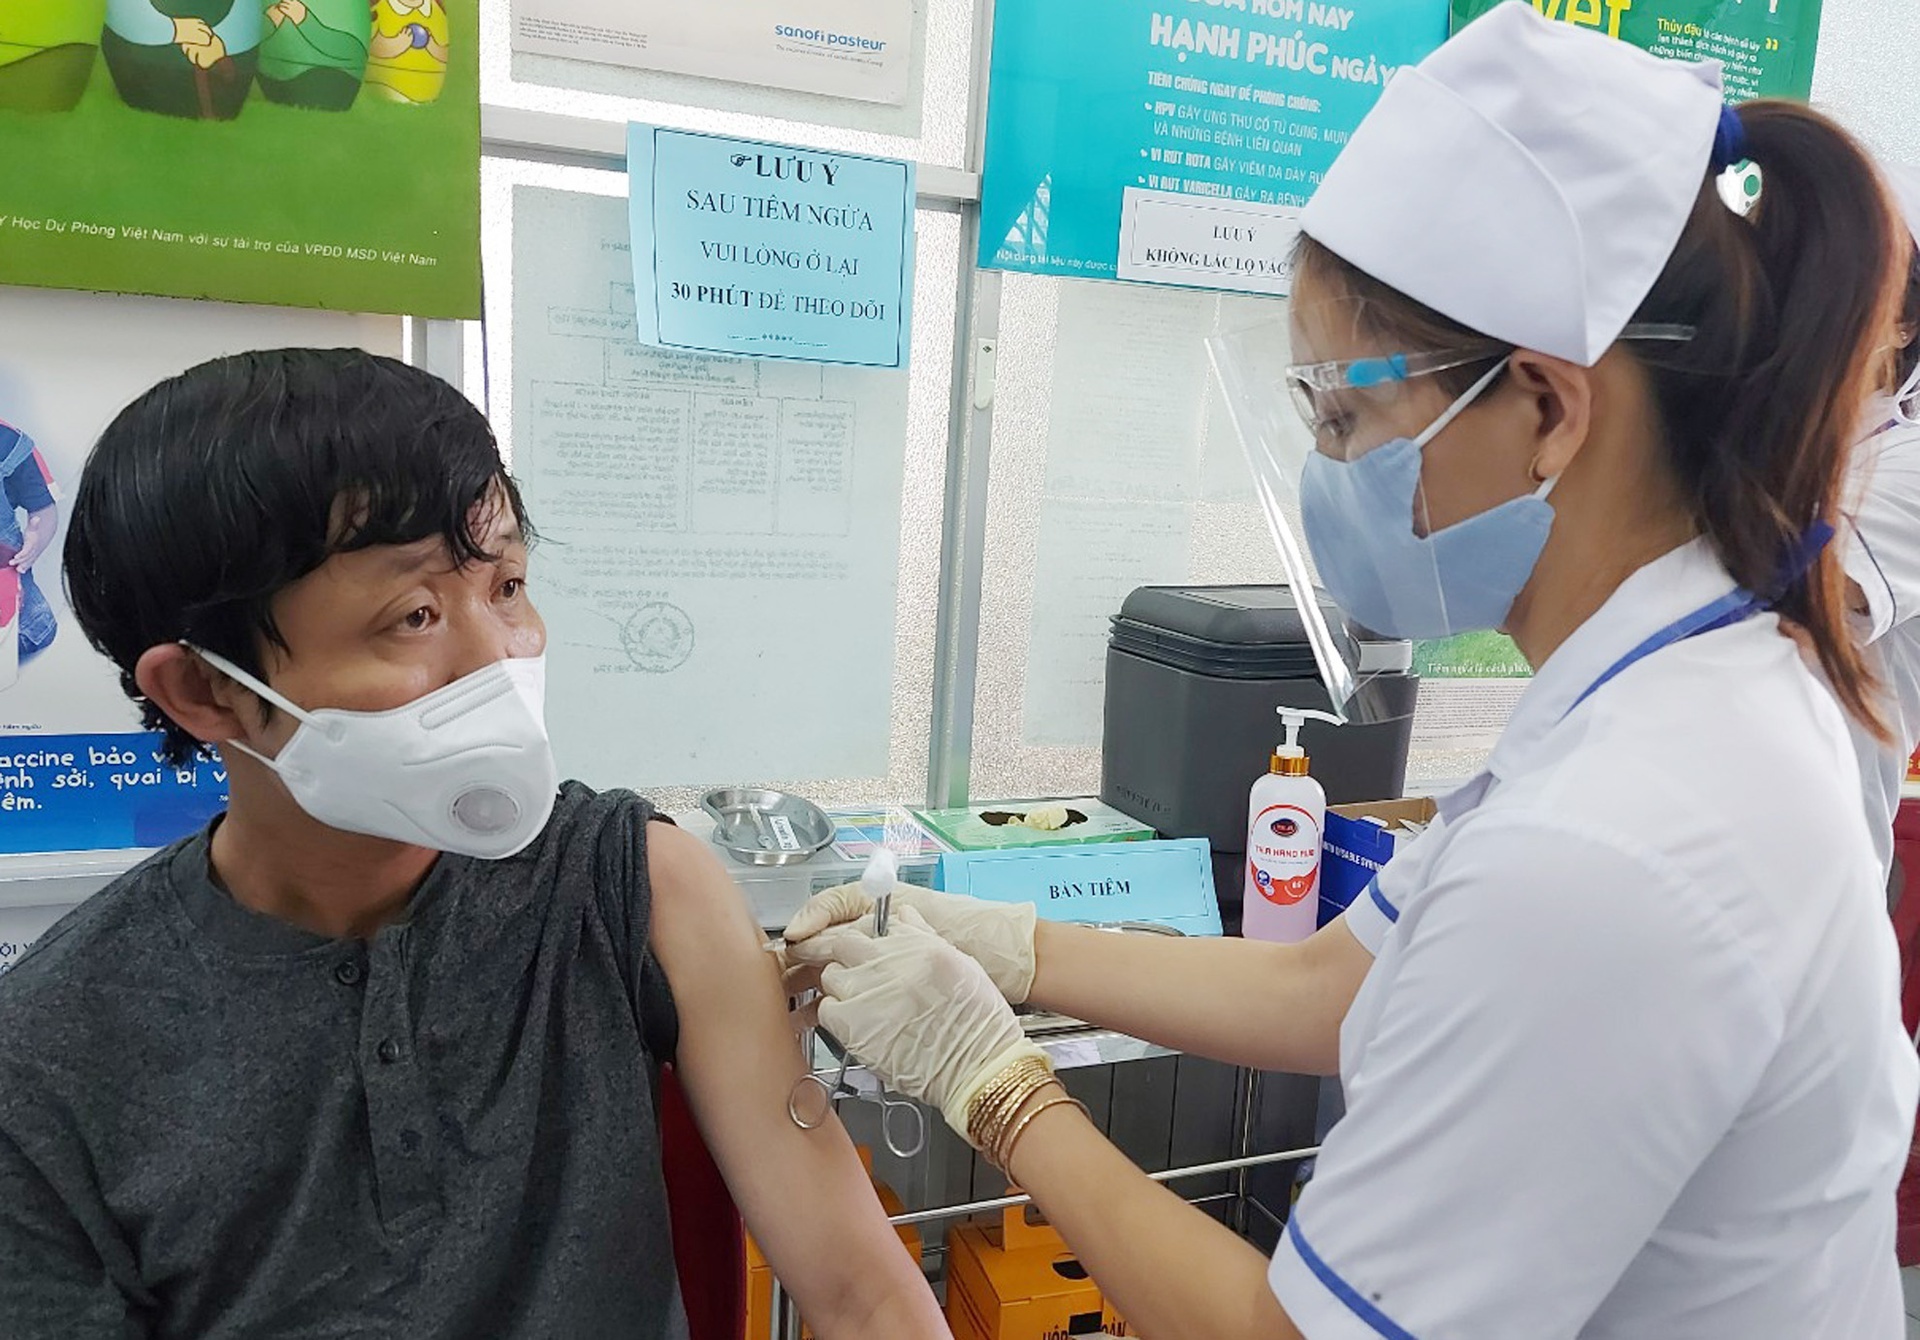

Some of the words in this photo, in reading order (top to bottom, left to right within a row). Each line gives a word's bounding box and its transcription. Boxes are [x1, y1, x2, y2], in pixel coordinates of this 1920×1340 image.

[1308, 2, 1354, 31] NAY
[774, 25, 824, 41] sanofi
[827, 32, 887, 51] pasteur
[1150, 12, 1241, 63] HẠNH
[1246, 29, 1328, 75] PHÚC
[1209, 82, 1237, 99] NGAY
[1153, 119, 1169, 136] VÀ
[1272, 139, 1302, 157] QUAN
[755, 153, 815, 185] LƯU
[823, 158, 841, 186] Ý
[1185, 152, 1211, 169] ROTA
[1182, 179, 1233, 198] VARICELLA
[686, 189, 736, 214] SAU
[743, 193, 801, 223] TIÊM
[806, 204, 874, 232] NGỪA
[12, 216, 41, 231] Học
[121, 225, 148, 241] Việt
[152, 229, 184, 243] Nam
[345, 247, 378, 262] MSD
[380, 250, 406, 266] Việt
[408, 253, 438, 267] Nam
[1213, 225, 1244, 241] LƯU
[1247, 226, 1258, 242] Ý
[700, 240, 738, 261] VUI
[743, 242, 801, 270] LÒNG
[826, 255, 860, 279] LẠI
[1146, 247, 1200, 267] KHÔNG
[671, 281, 691, 300] 30
[697, 284, 753, 308] PHÚT
[791, 295, 845, 318] THEO
[0, 750, 74, 768] accine
[88, 746, 137, 766] bảo
[51, 767, 95, 789] sởi,
[110, 768, 162, 791] quai
[175, 766, 198, 788] bị
[1273, 847, 1299, 859] HAND
[1050, 880, 1084, 900] BÀN
[1088, 877, 1132, 898] TIÊM
